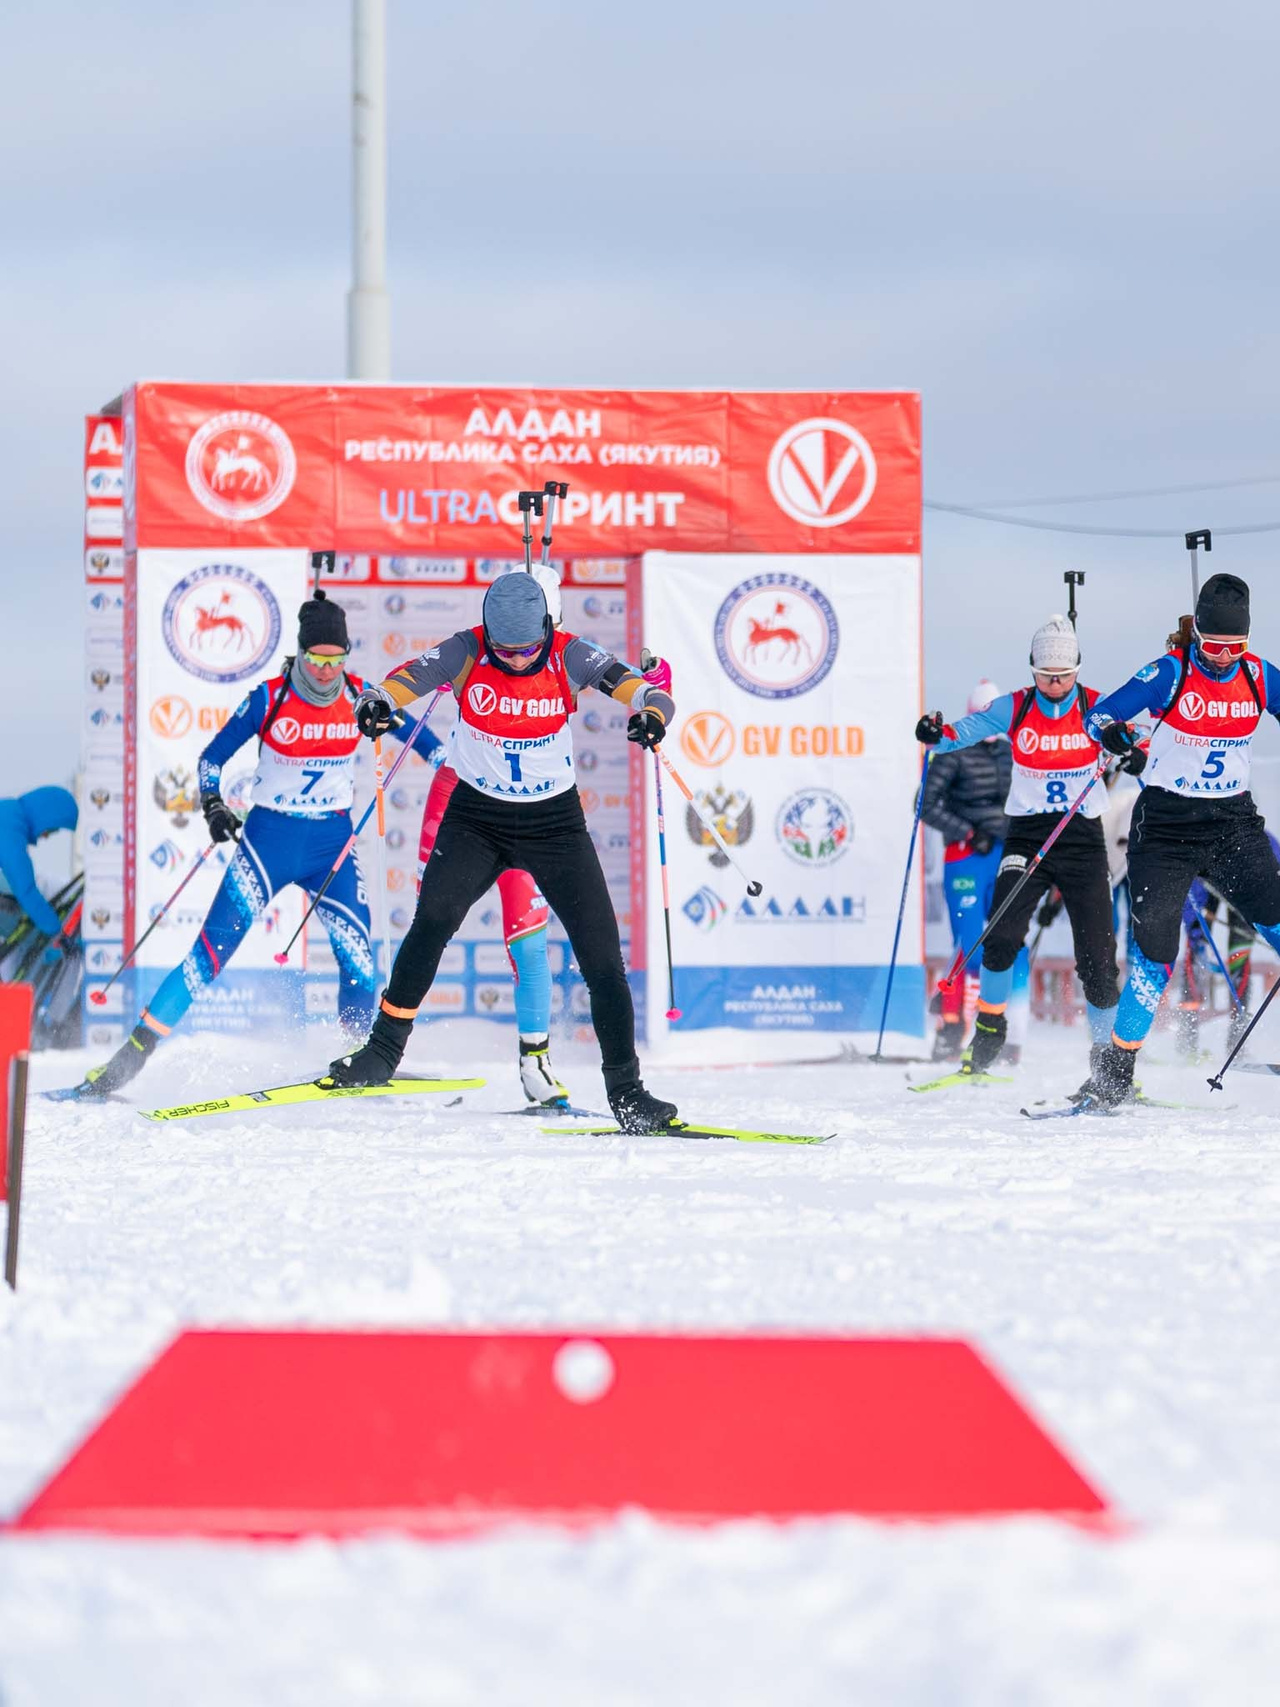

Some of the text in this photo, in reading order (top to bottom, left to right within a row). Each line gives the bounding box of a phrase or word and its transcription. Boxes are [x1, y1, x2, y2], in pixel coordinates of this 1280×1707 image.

[464, 409, 600, 440] АЛДАН
[345, 440, 721, 468] РЕСПУБЛИКА САХА (ЯКУТИЯ)
[499, 697, 523, 716] GV
[1207, 701, 1228, 718] GV
[302, 723, 325, 740] GV
[742, 726, 864, 758] GV GOLD
[1040, 735, 1060, 751] GV
[504, 752, 522, 782] 1
[1201, 750, 1227, 779] 5
[300, 770, 325, 795] 7
[1046, 780, 1068, 804] 8
[753, 986, 816, 1000] АЛДАН
[168, 1099, 230, 1117] FISCHER
